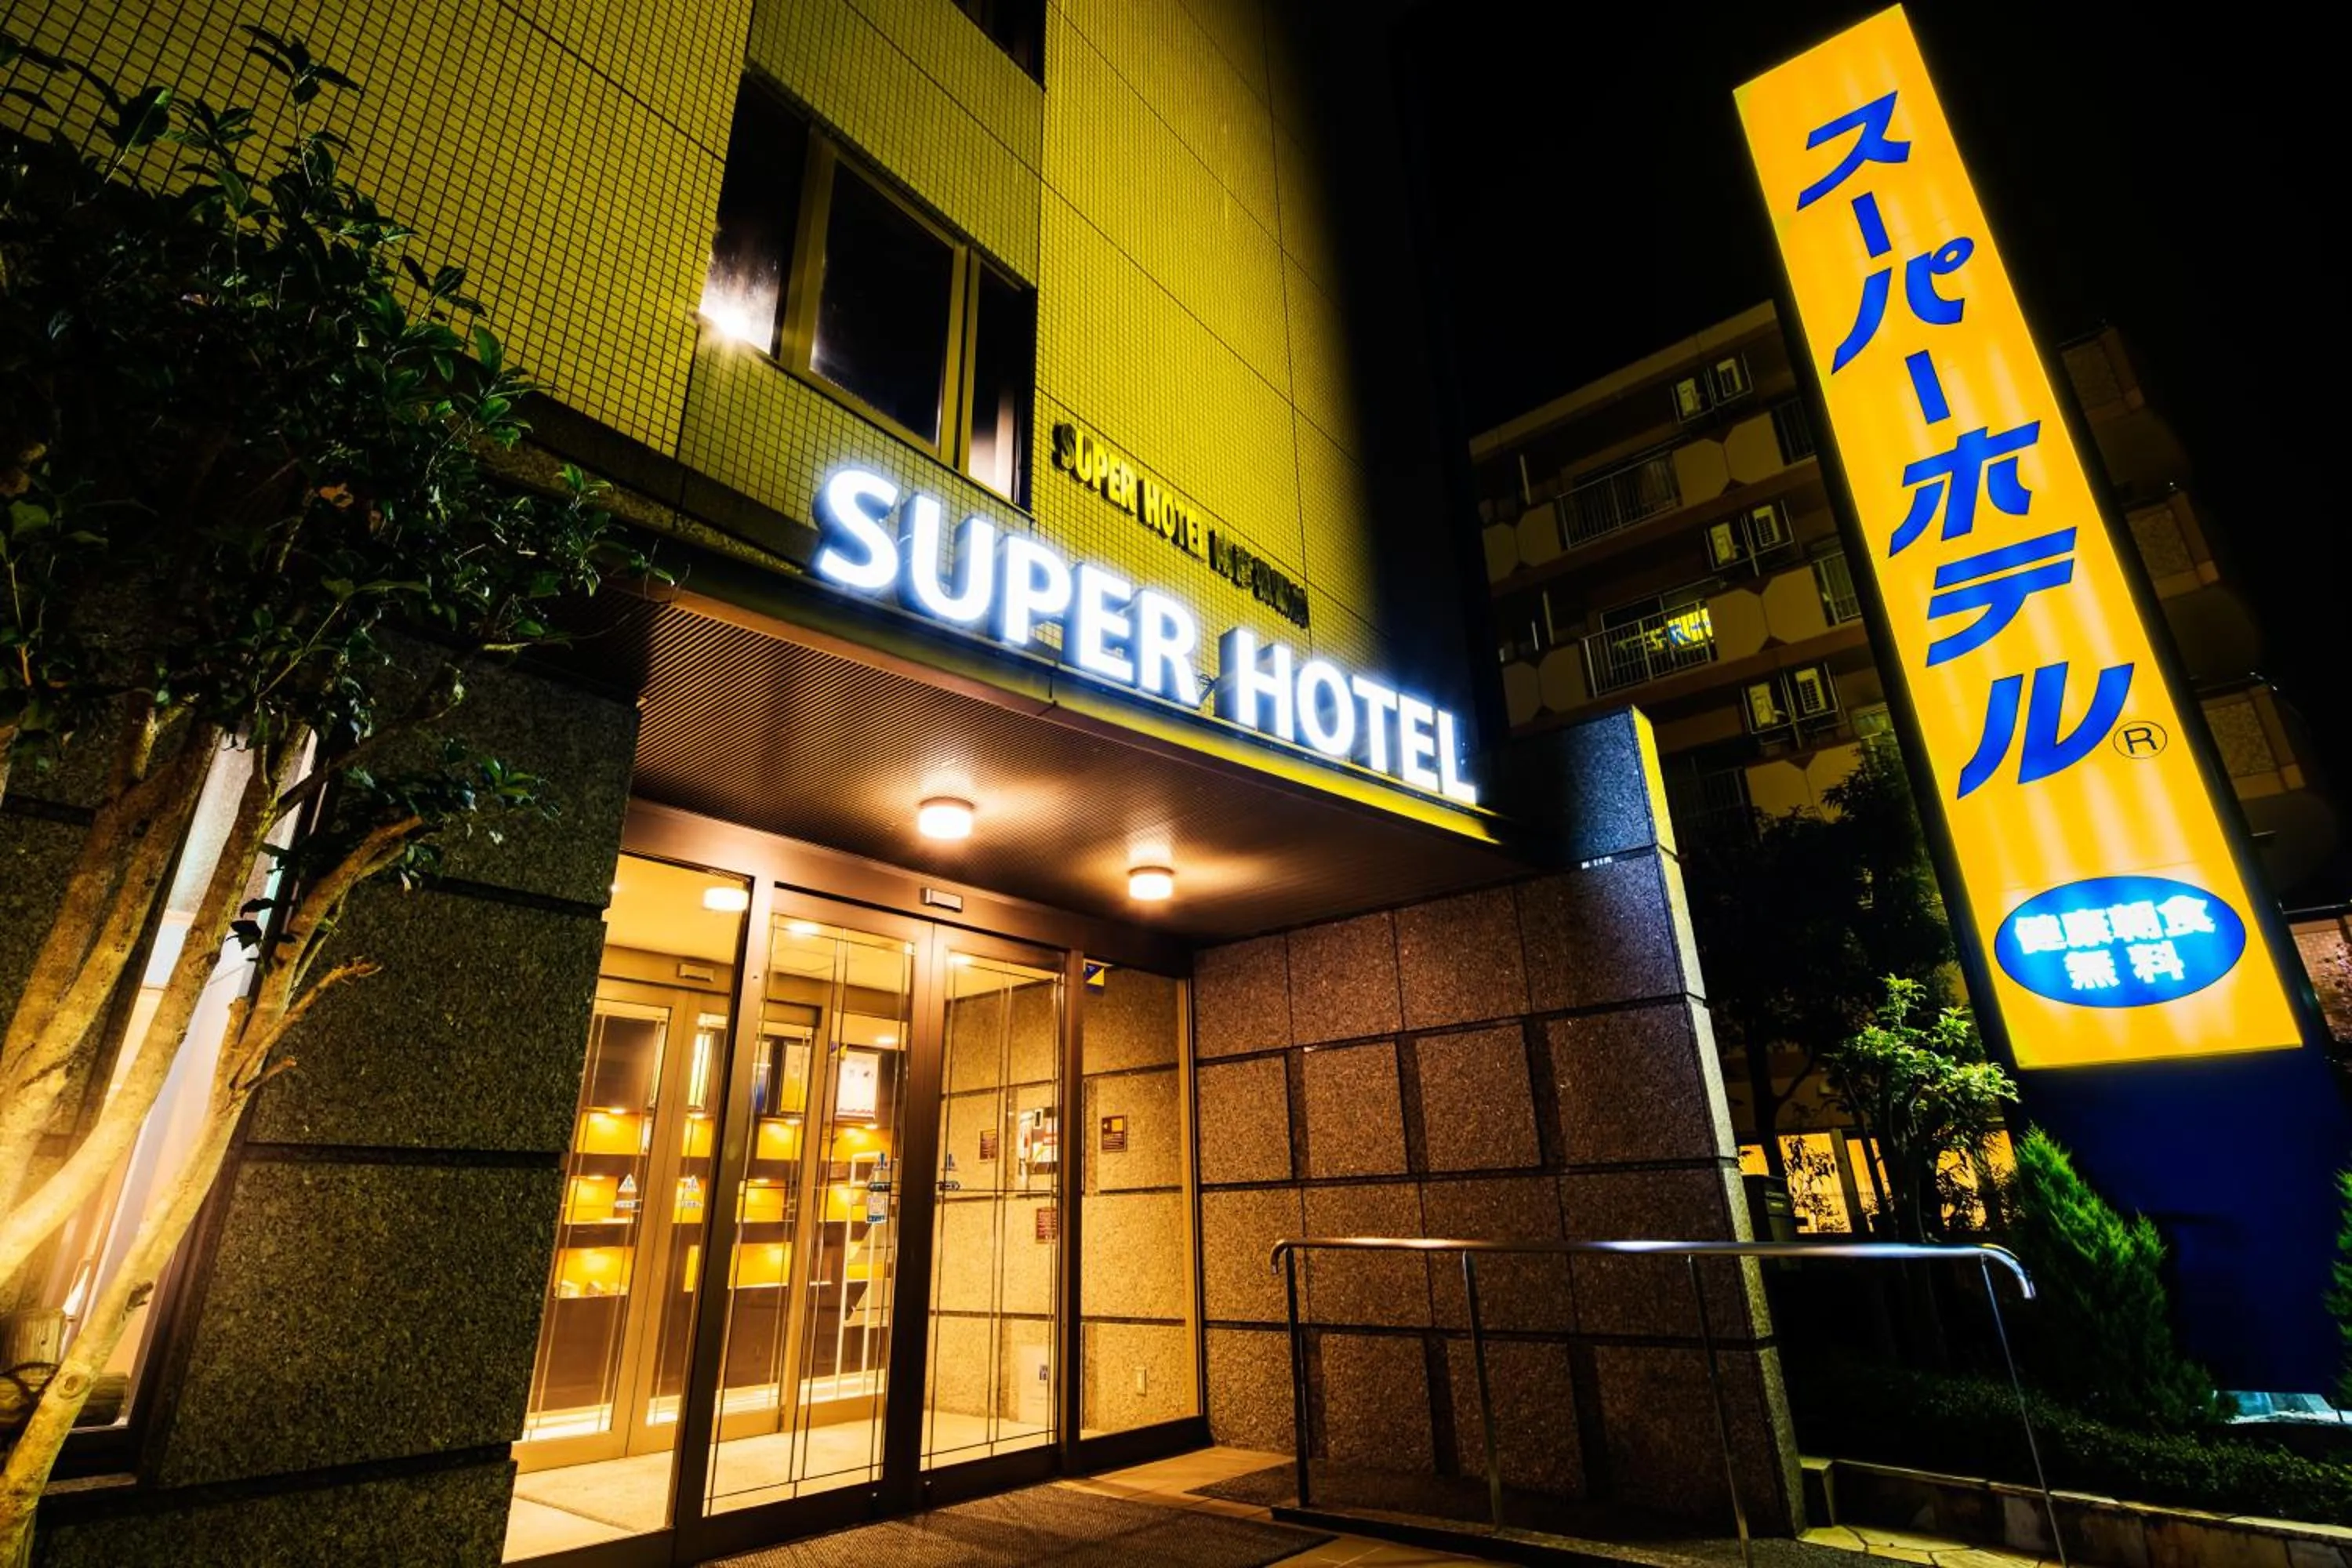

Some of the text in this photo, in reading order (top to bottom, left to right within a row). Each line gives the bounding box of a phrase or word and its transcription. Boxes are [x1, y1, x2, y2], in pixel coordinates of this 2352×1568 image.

[1051, 423, 1207, 563] SUPER HOTEL
[1796, 90, 2134, 800] スーパーホテル
[817, 468, 1201, 707] SUPER
[1229, 628, 1479, 805] HOTEL
